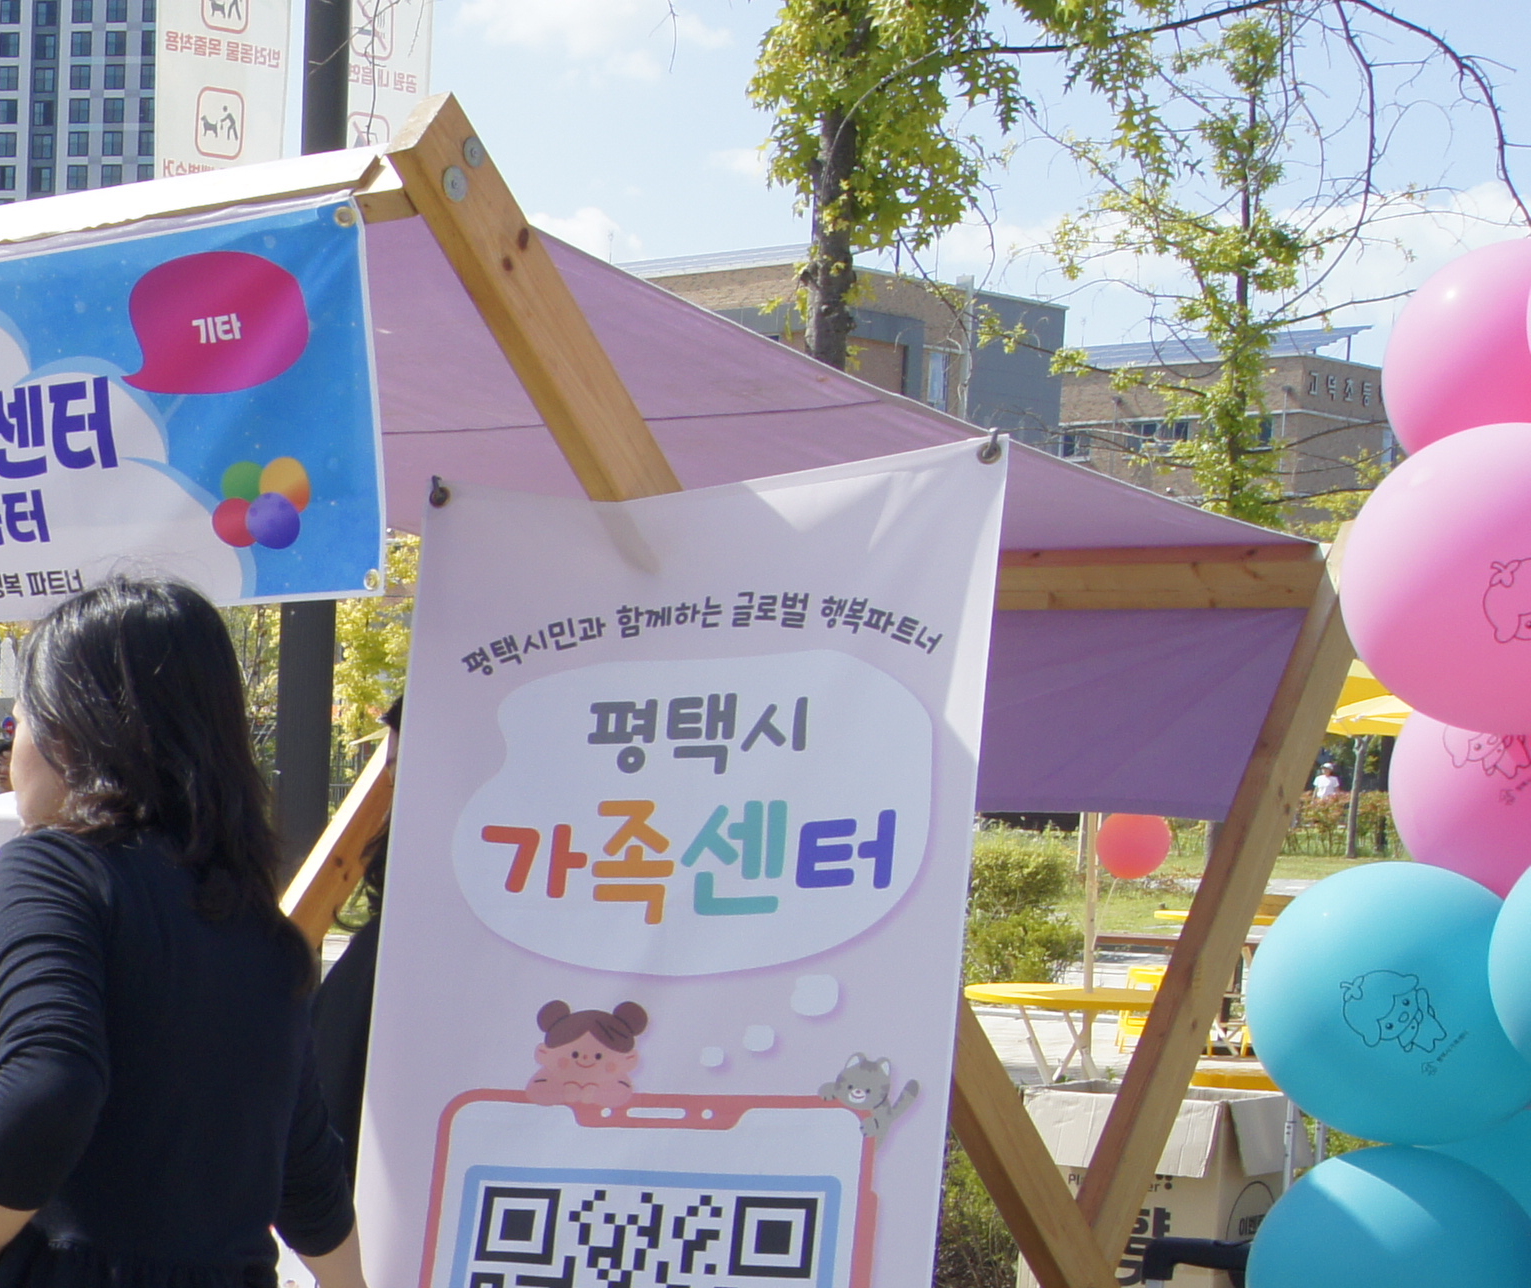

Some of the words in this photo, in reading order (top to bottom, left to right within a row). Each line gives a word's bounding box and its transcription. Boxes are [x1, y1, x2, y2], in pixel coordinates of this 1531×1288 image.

[192, 313, 242, 345] 기타
[1308, 370, 1382, 406] 고덕초등
[26, 568, 84, 597] 파트너
[461, 615, 607, 677] 평택시민과
[616, 596, 723, 638] 함께하는
[732, 591, 810, 629] 글로벌
[820, 595, 944, 655] 행복파트너
[587, 692, 809, 775] 평택시
[481, 799, 897, 926] 가족센터
